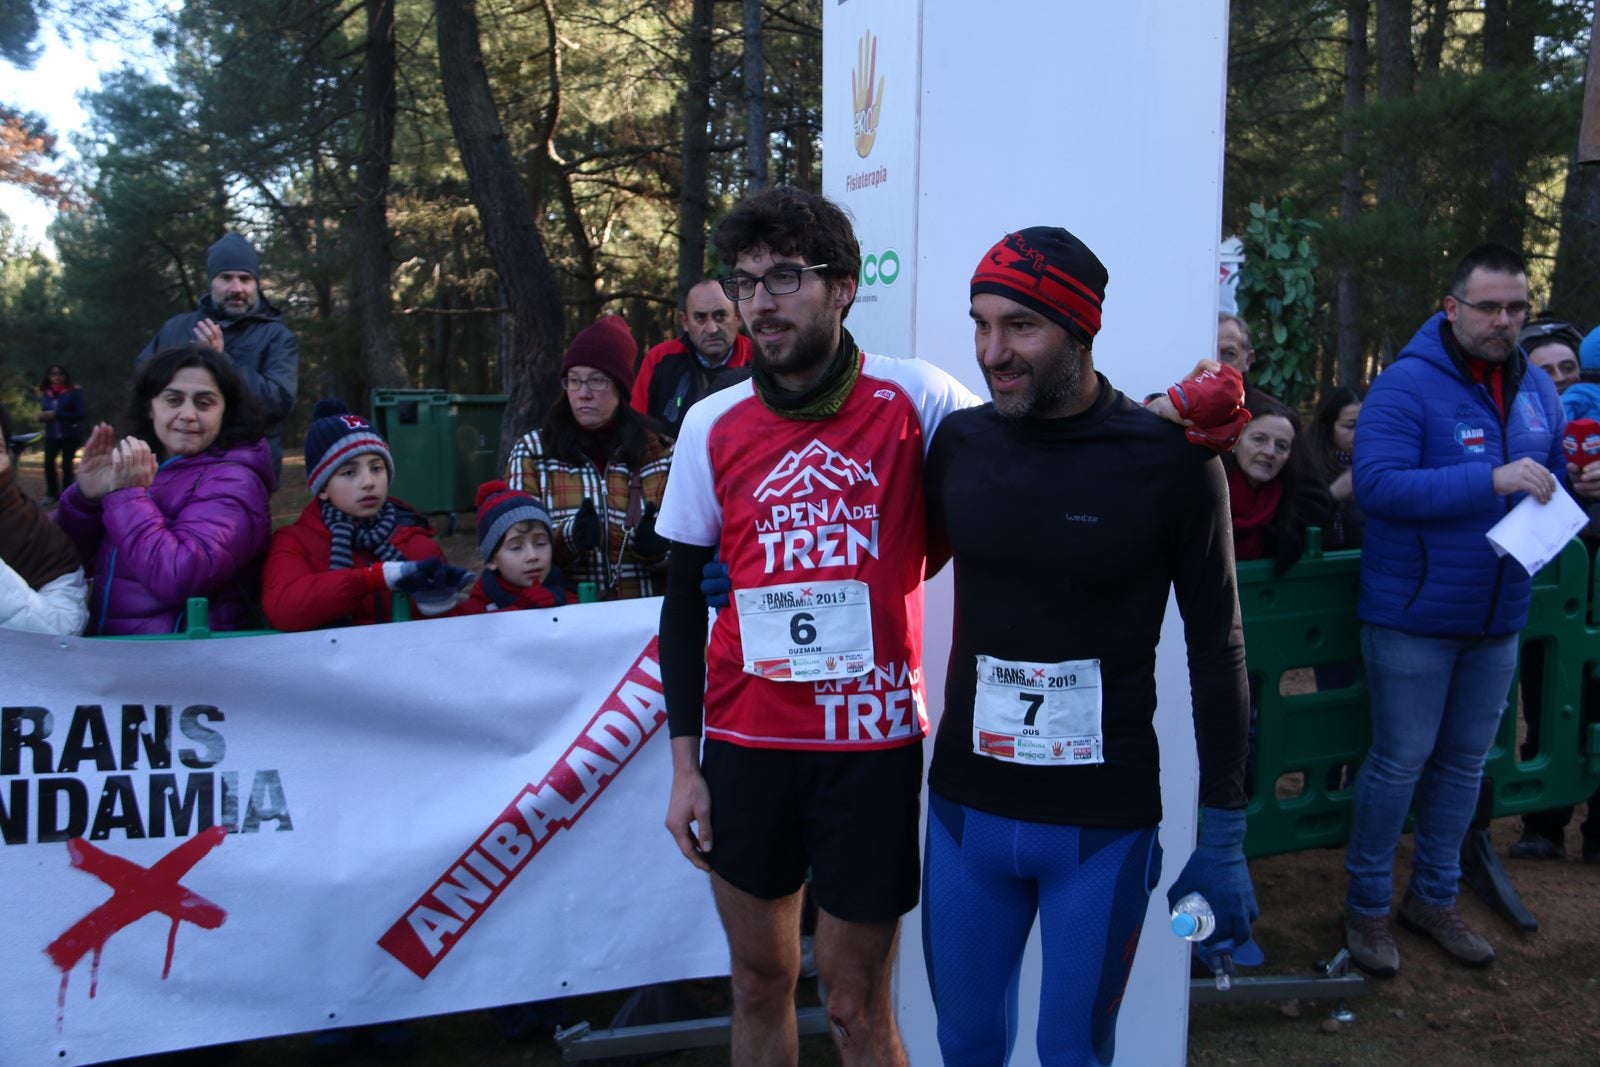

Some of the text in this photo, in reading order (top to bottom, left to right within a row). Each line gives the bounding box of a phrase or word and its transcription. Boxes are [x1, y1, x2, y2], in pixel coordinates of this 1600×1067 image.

[846, 165, 887, 193] Fisioterapia
[755, 519, 774, 532] LA
[853, 504, 880, 520] DEL
[758, 520, 880, 574] TREN
[816, 592, 846, 605] 2019
[790, 612, 817, 646] 6
[789, 646, 822, 655] GUZMAN
[1048, 674, 1077, 688] 2019
[1019, 692, 1044, 726] 7
[0, 703, 227, 776] RANS
[1022, 728, 1040, 736] OUS
